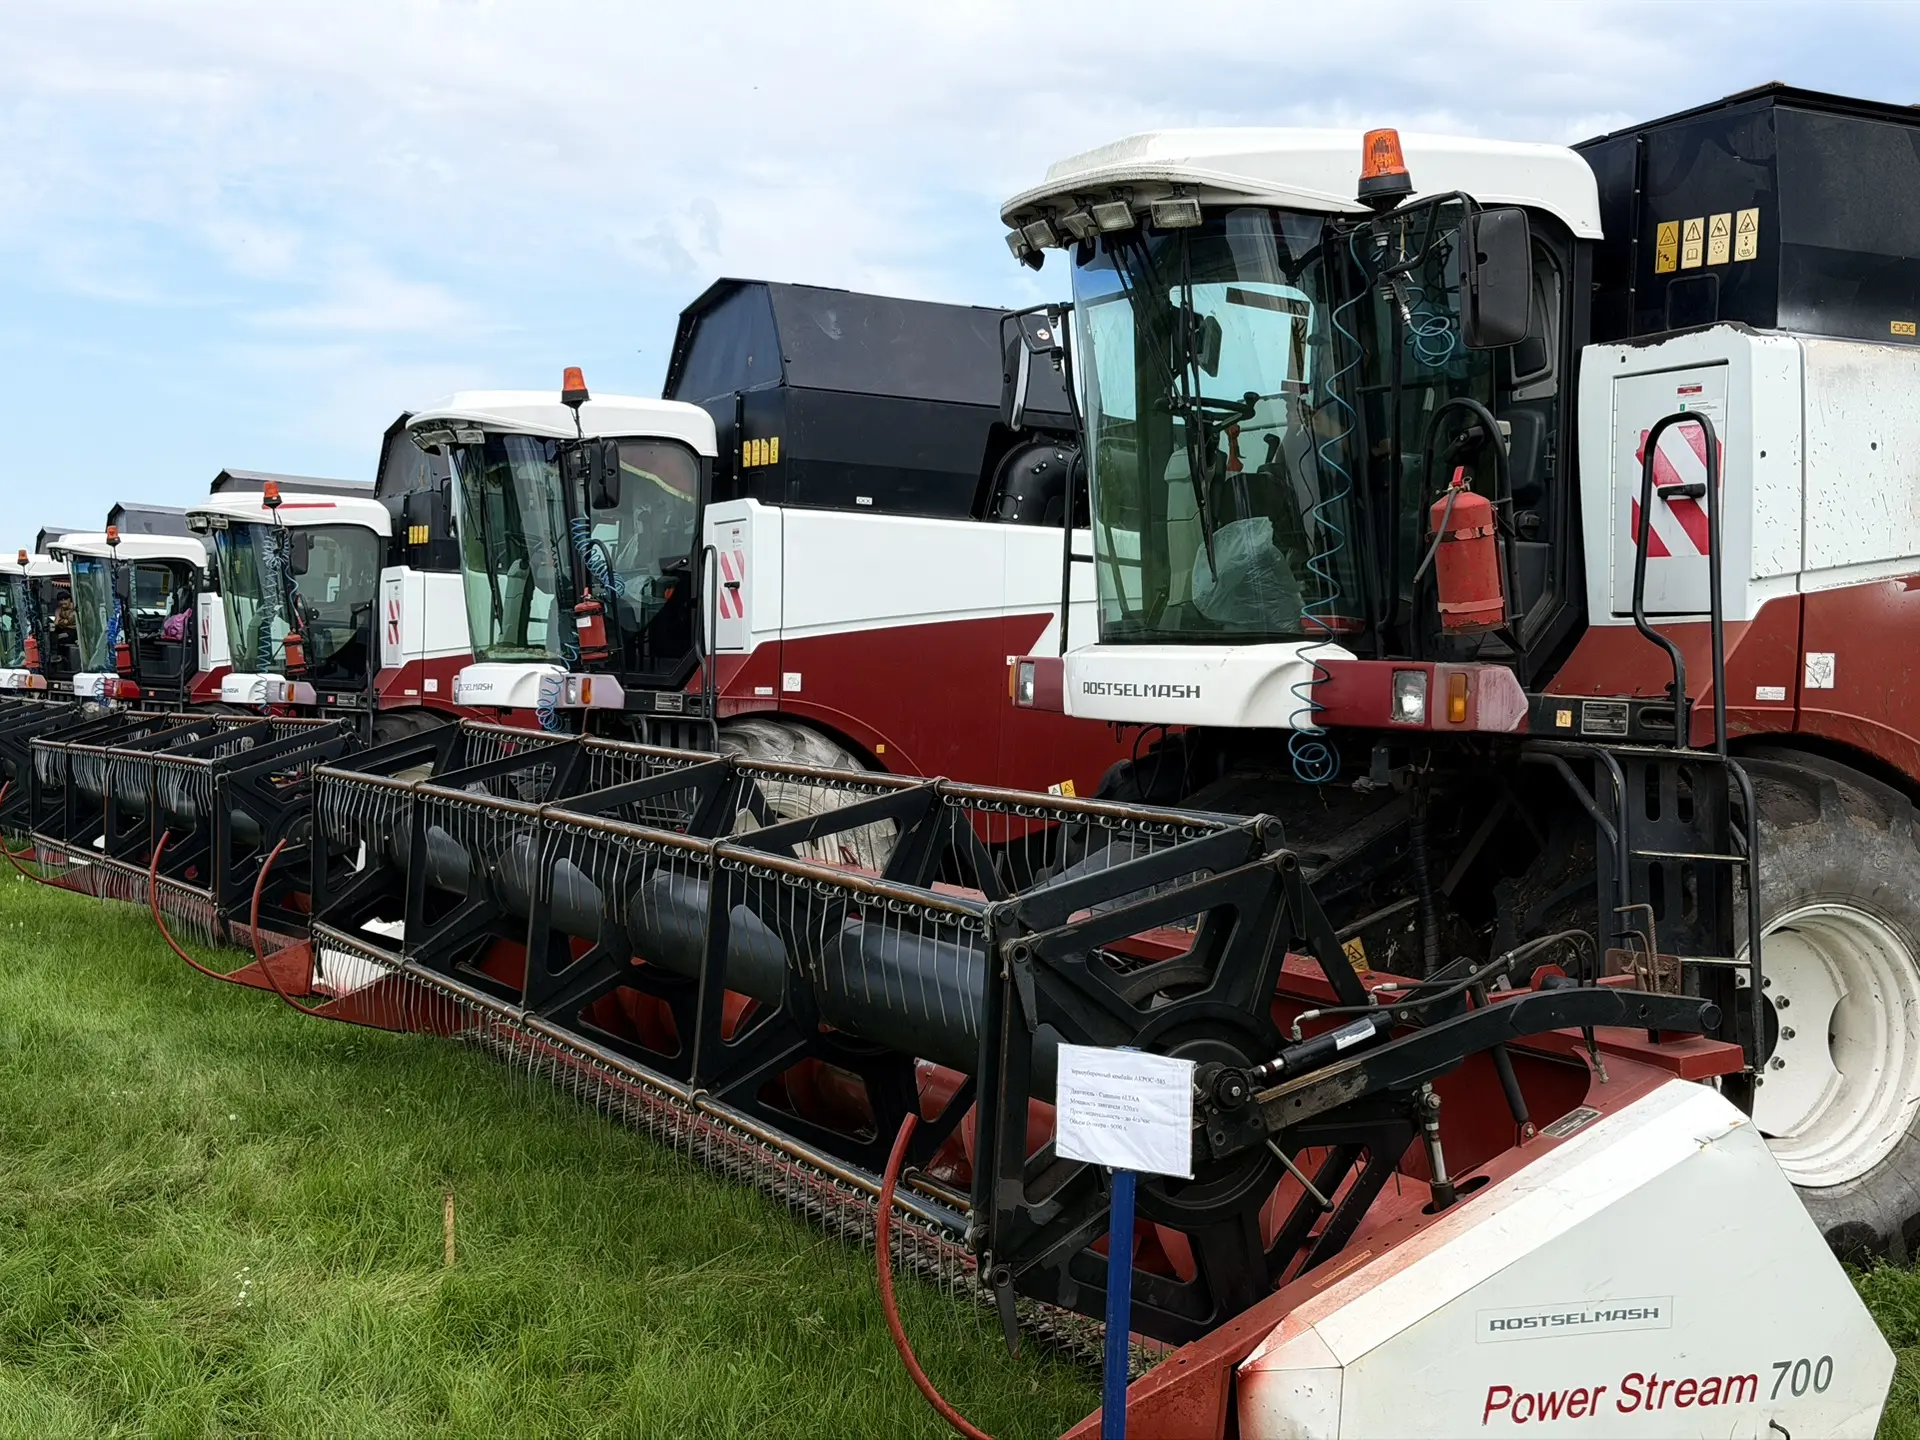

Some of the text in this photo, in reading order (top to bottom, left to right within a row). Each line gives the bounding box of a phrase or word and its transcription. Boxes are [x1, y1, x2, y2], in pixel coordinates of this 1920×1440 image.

[1083, 682, 1201, 699] ROSTSELMASH
[1489, 1307, 1660, 1332] ROSTSELMASH
[1481, 1355, 1835, 1427] Power Stream 700
